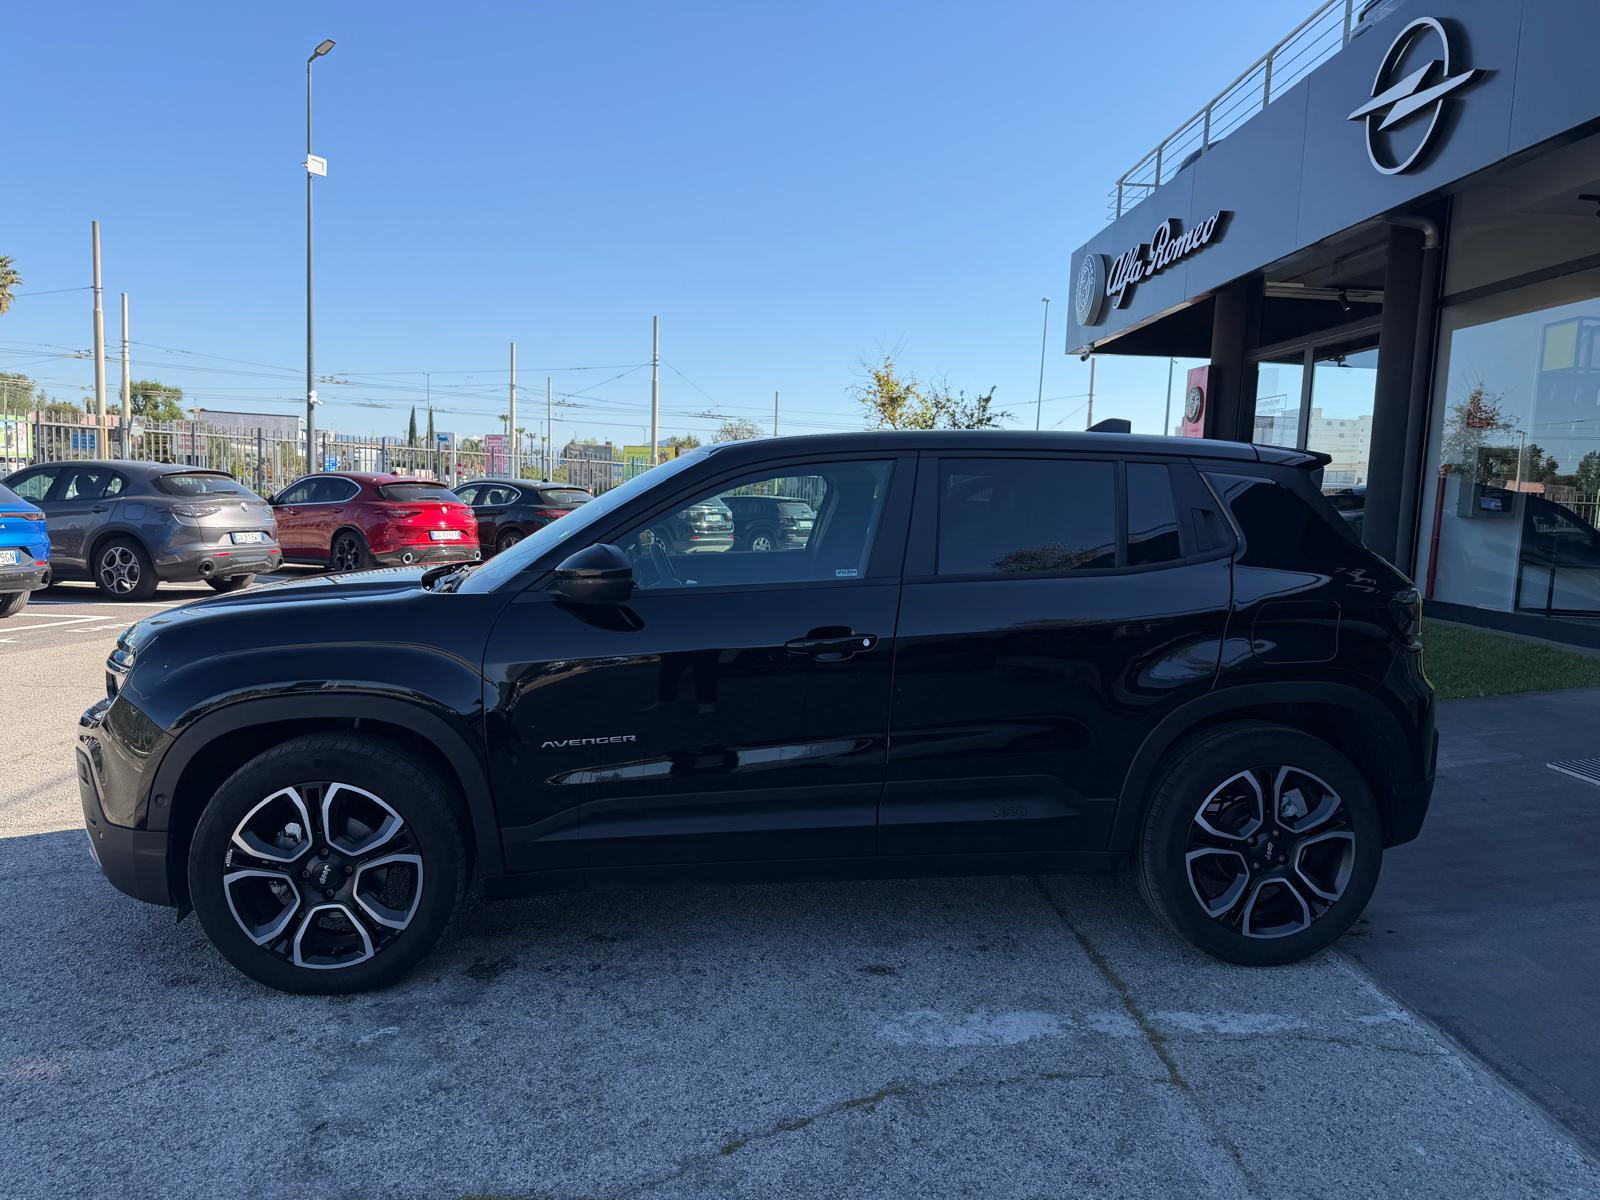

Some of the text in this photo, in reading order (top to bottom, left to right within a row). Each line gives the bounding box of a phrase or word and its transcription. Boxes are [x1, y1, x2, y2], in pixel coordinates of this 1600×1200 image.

[1106, 244, 1145, 309] Alfa
[1145, 211, 1220, 276] Romeo
[541, 734, 638, 749] AVENGER
